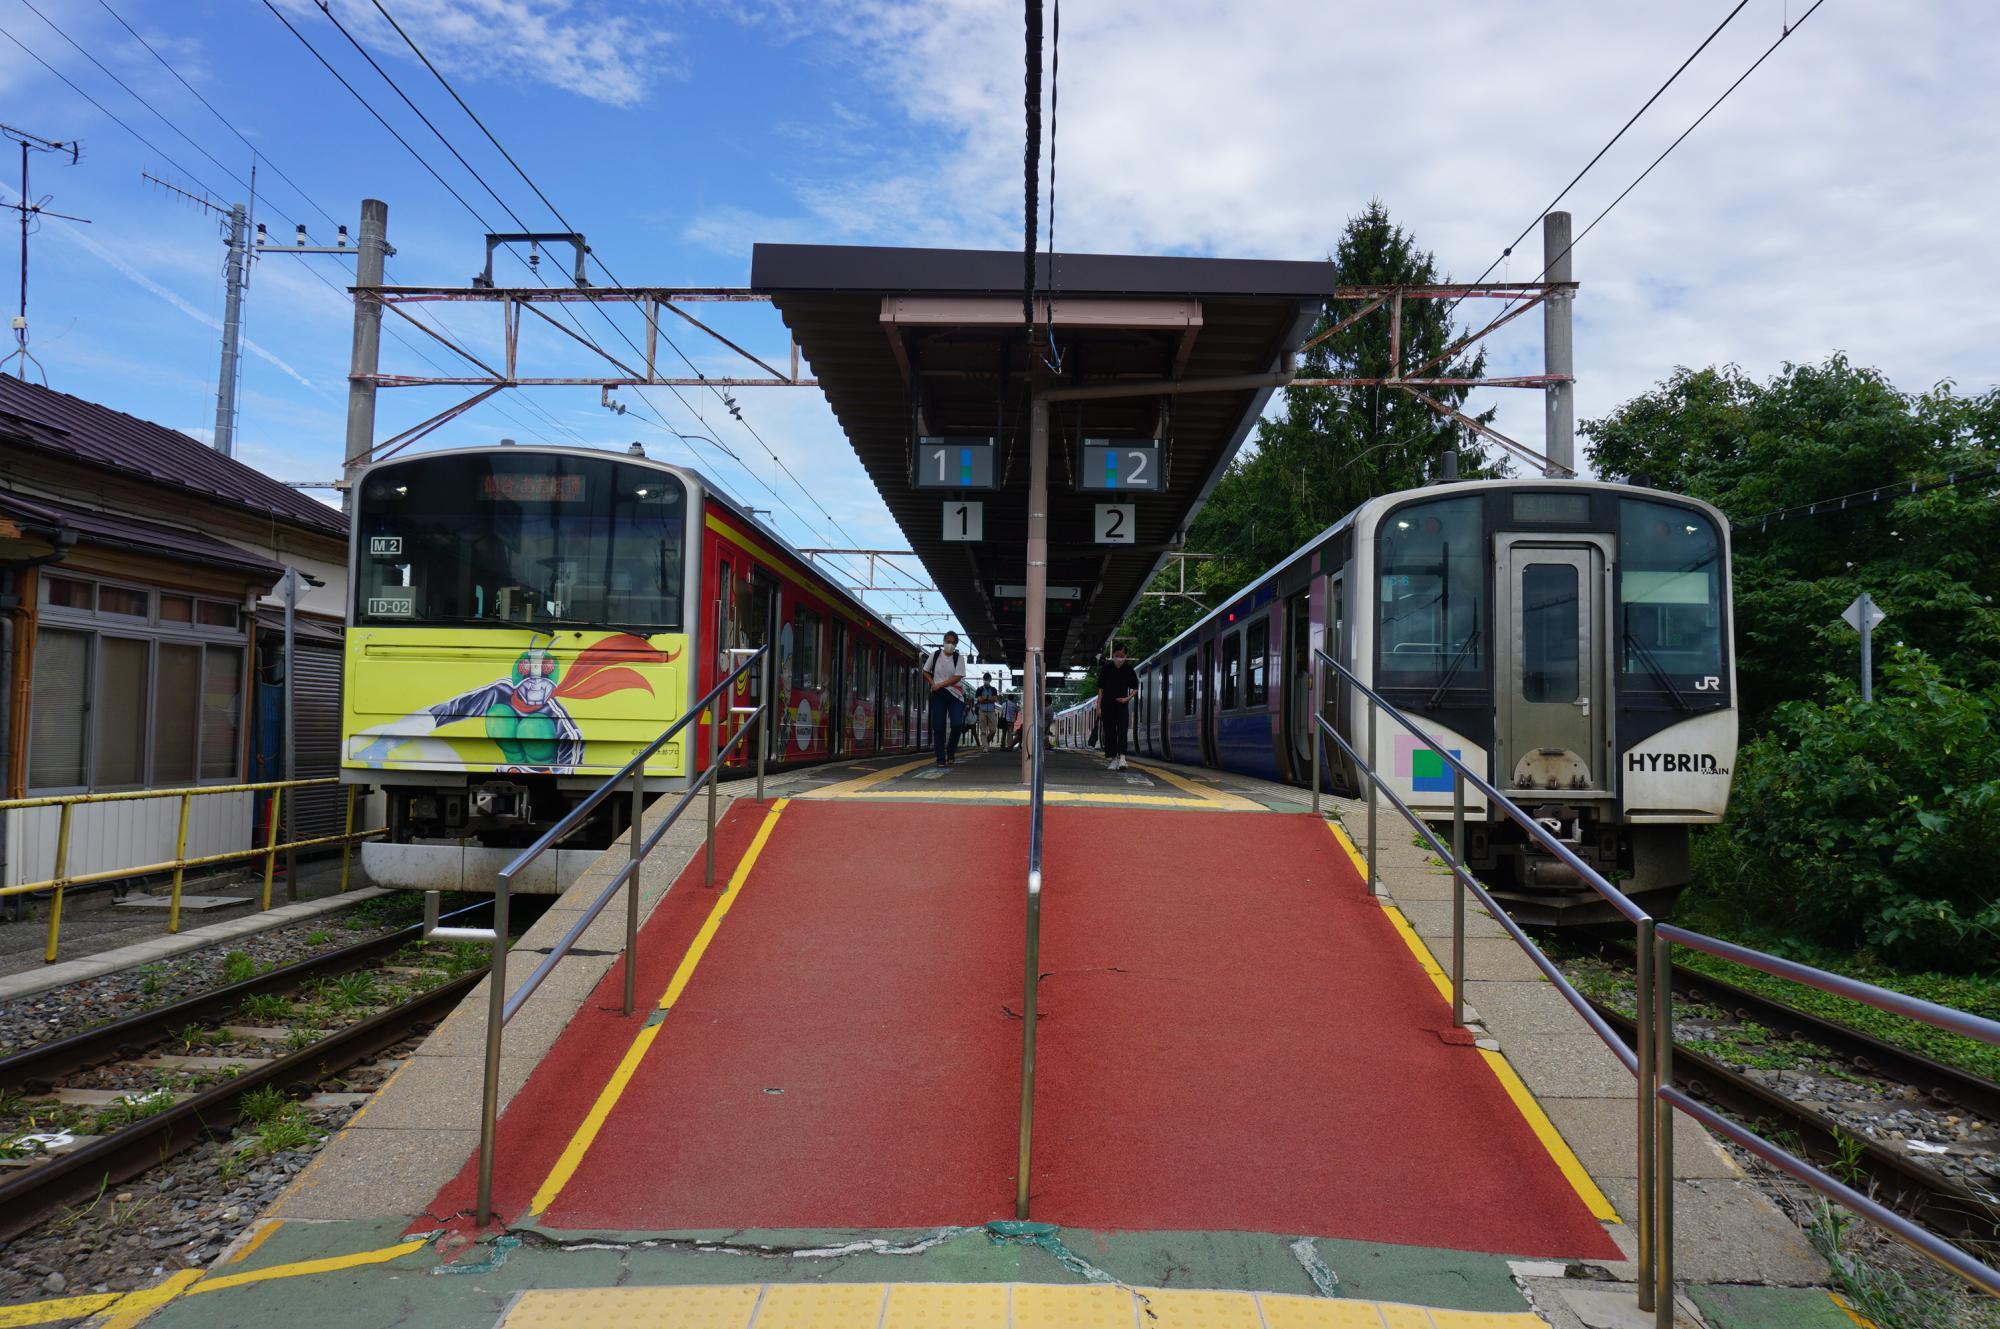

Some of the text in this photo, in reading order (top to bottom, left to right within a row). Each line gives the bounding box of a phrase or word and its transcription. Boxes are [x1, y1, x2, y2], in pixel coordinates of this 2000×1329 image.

[933, 449, 946, 481] 1
[1126, 451, 1148, 484] 2
[956, 506, 968, 536] 1
[1105, 509, 1125, 539] 2
[998, 586, 1003, 596] 1
[1071, 588, 1079, 598] 2
[373, 600, 409, 613] ID-02
[1694, 676, 1721, 691] JR
[1628, 753, 1718, 772] HYBRID
[1700, 767, 1729, 776] TRAIN
